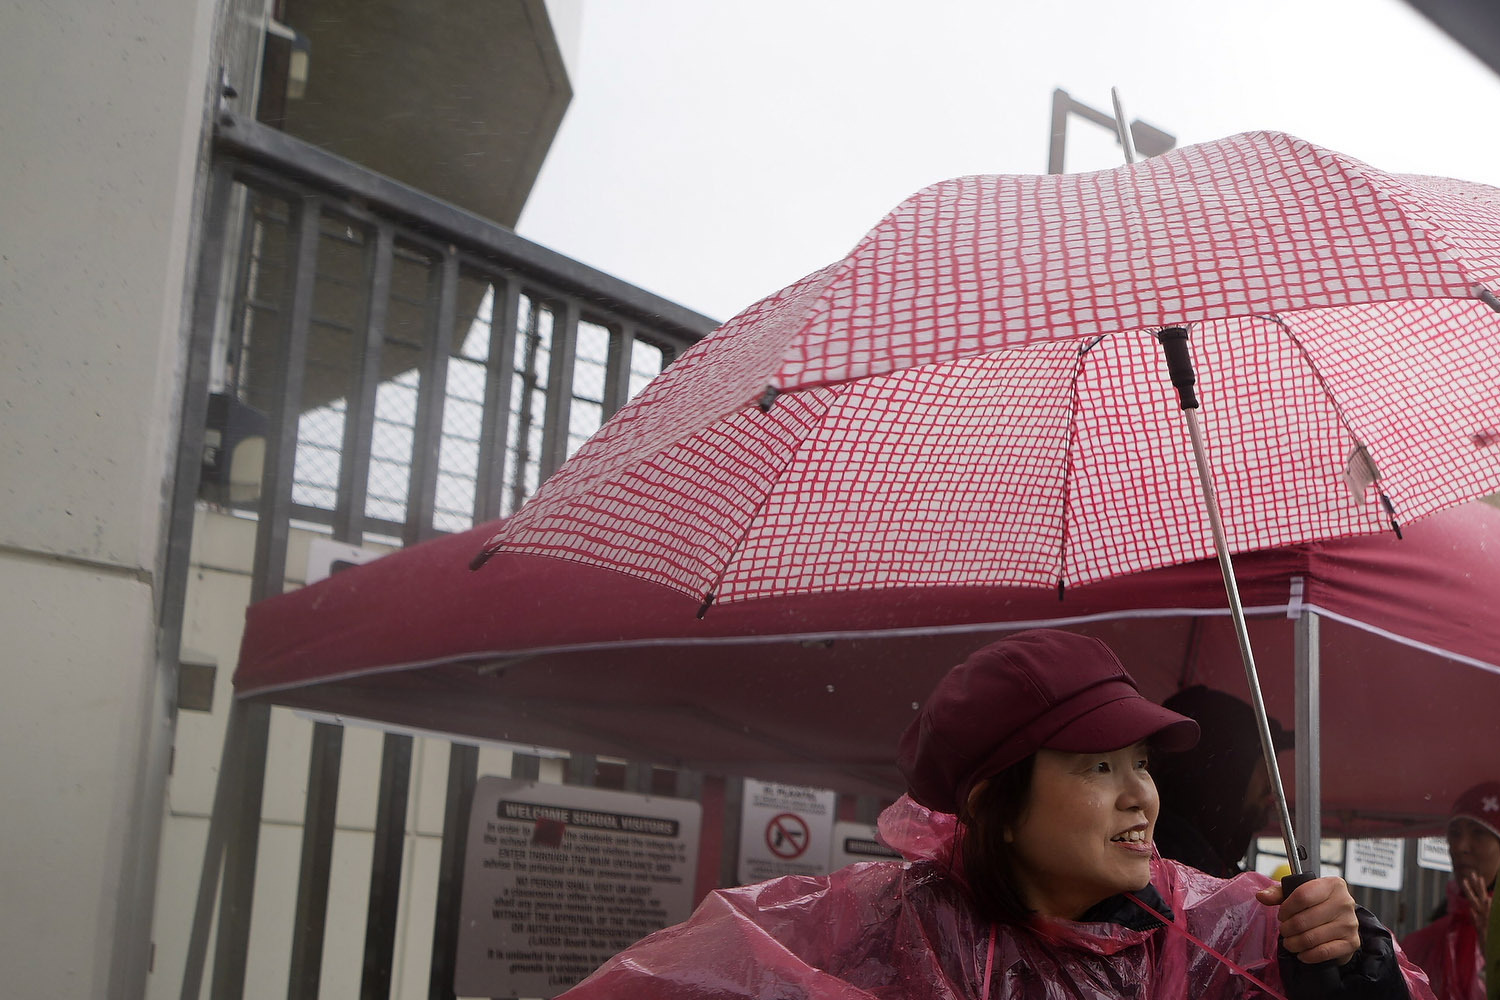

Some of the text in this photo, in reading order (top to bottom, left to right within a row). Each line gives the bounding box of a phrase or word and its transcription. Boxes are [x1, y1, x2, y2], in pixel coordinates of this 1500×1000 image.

[505, 803, 672, 834] WELCOME SCHOOL VISITORS
